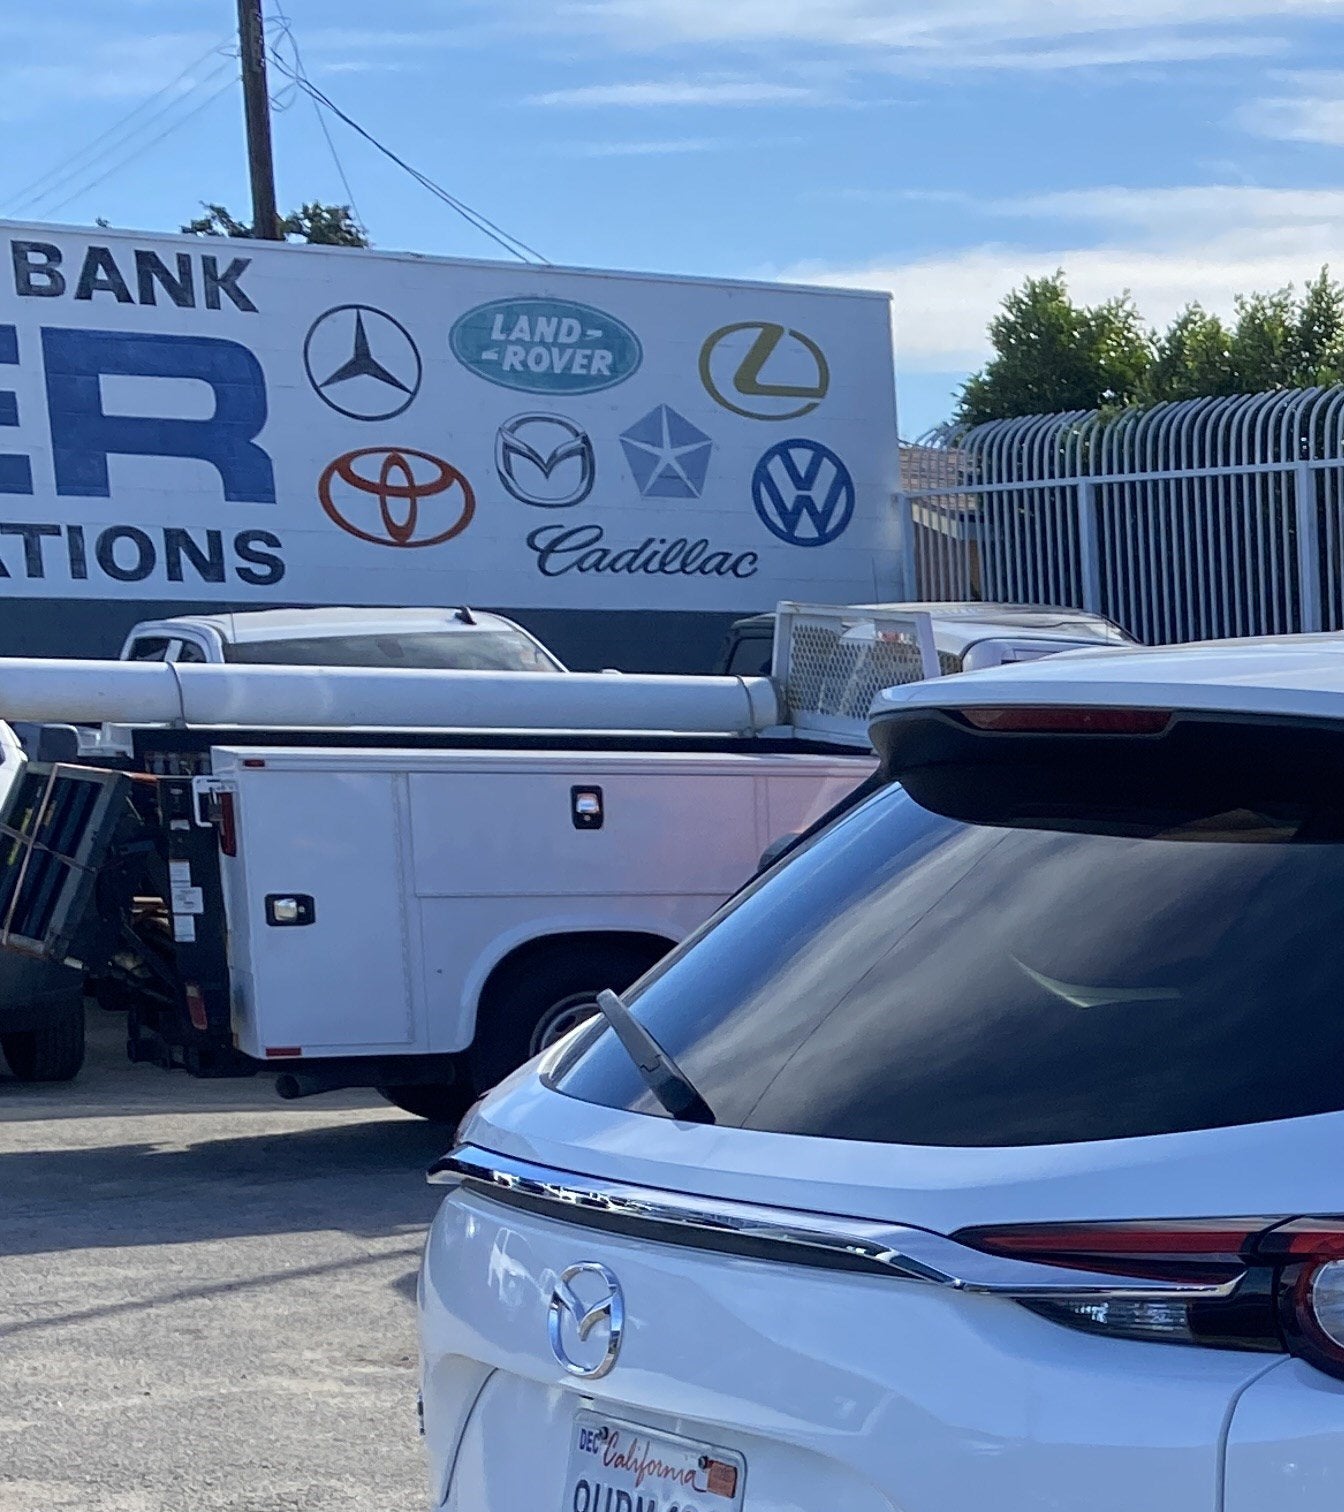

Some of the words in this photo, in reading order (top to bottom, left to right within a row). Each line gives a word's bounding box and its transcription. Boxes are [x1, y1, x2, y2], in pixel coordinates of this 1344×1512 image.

[10, 240, 259, 313] BANK
[490, 313, 581, 344] LAND
[501, 345, 614, 377] ROVER
[0, 522, 286, 586] TIONS
[526, 524, 759, 578] Cadillac
[579, 1428, 600, 1454] DEC
[602, 1430, 708, 1493] California
